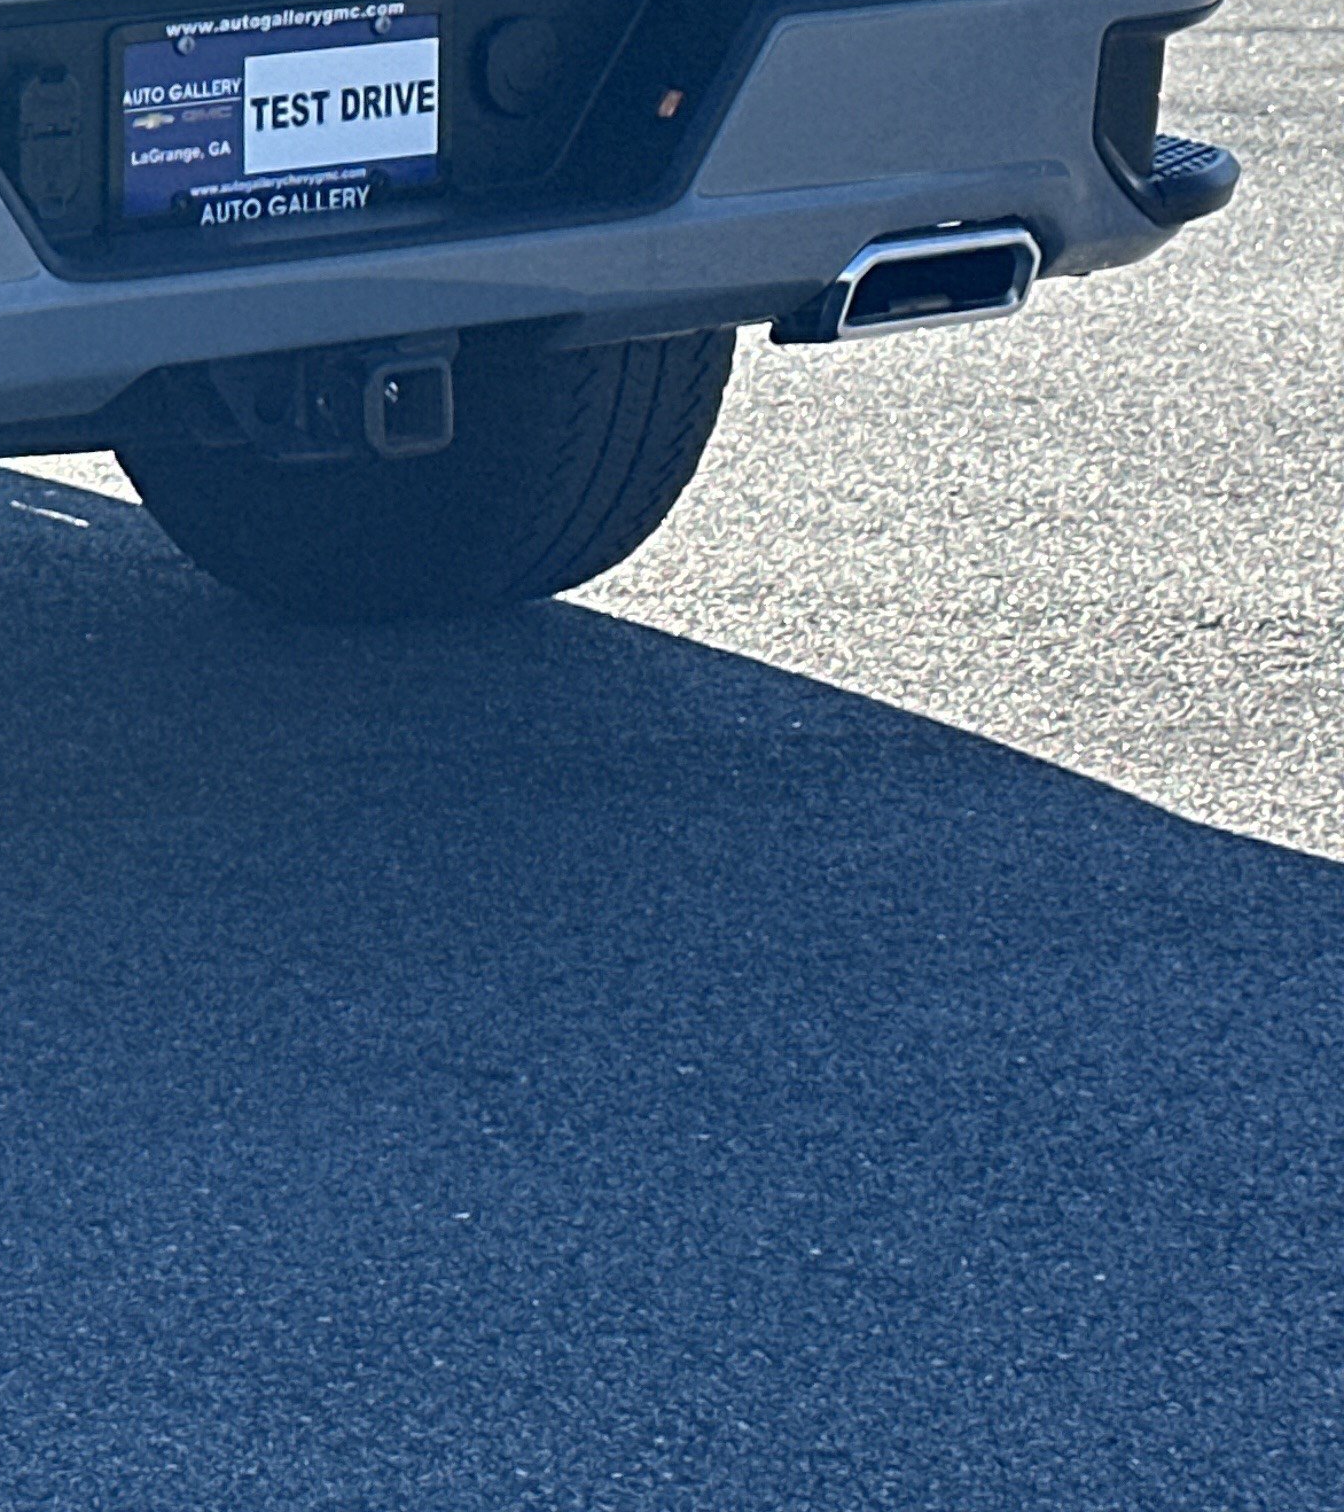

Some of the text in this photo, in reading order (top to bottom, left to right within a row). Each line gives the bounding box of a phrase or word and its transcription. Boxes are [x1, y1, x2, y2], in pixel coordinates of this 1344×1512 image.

[165, 1, 405, 37] www.autogallerygmc.com
[123, 78, 242, 107] AUTO GALLERY
[250, 80, 436, 132] TEST DRIVE
[131, 141, 232, 166] LaGrange, GA
[200, 184, 371, 227] AUTO GALLERY
